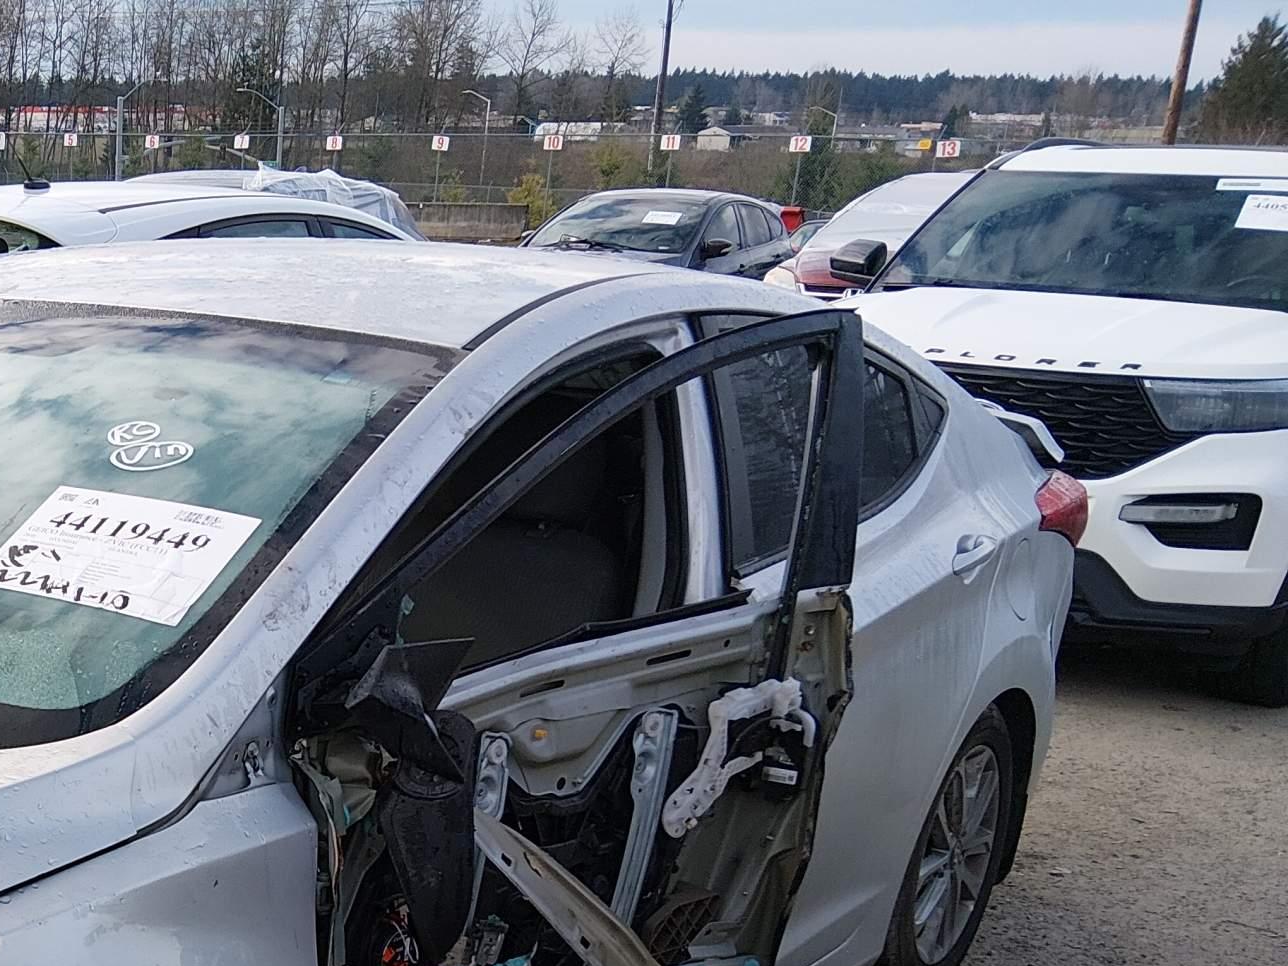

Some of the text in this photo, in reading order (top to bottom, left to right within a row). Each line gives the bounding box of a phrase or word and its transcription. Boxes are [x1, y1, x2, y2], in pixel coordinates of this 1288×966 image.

[67, 134, 73, 146] 5
[149, 136, 155, 148] 6
[239, 136, 245, 148] 7
[331, 137, 338, 149] 8
[437, 137, 444, 149] 9
[547, 136, 560, 149] 10
[665, 136, 676, 149] 11
[793, 137, 808, 151] 12
[941, 141, 957, 157] 13
[50, 511, 212, 553] 44119449
